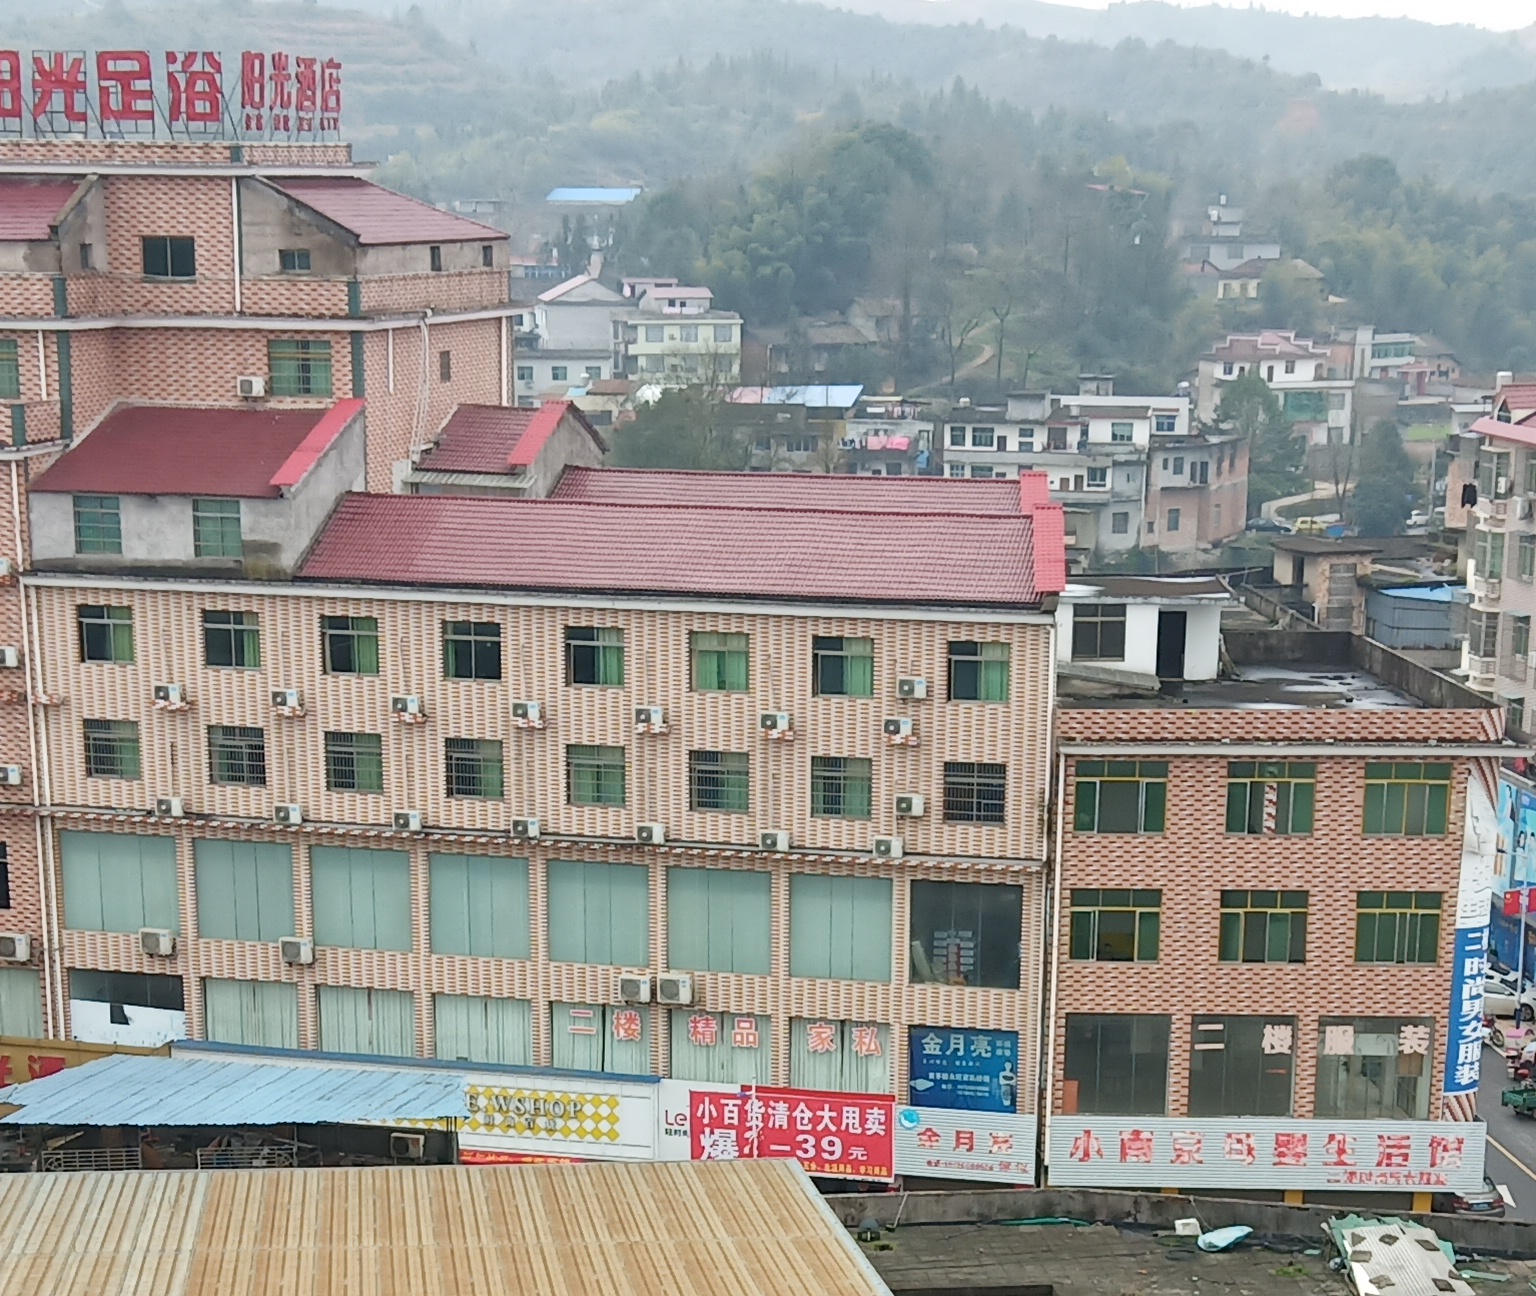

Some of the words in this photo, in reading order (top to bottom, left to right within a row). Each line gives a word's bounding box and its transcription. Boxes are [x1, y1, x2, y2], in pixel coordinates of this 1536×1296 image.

[241, 51, 341, 112] 阳光酒店
[921, 1033, 992, 1057] 金月亮
[1194, 1023, 1431, 1055] 二楼服装
[697, 1096, 887, 1137] 小百货清仓大甩卖
